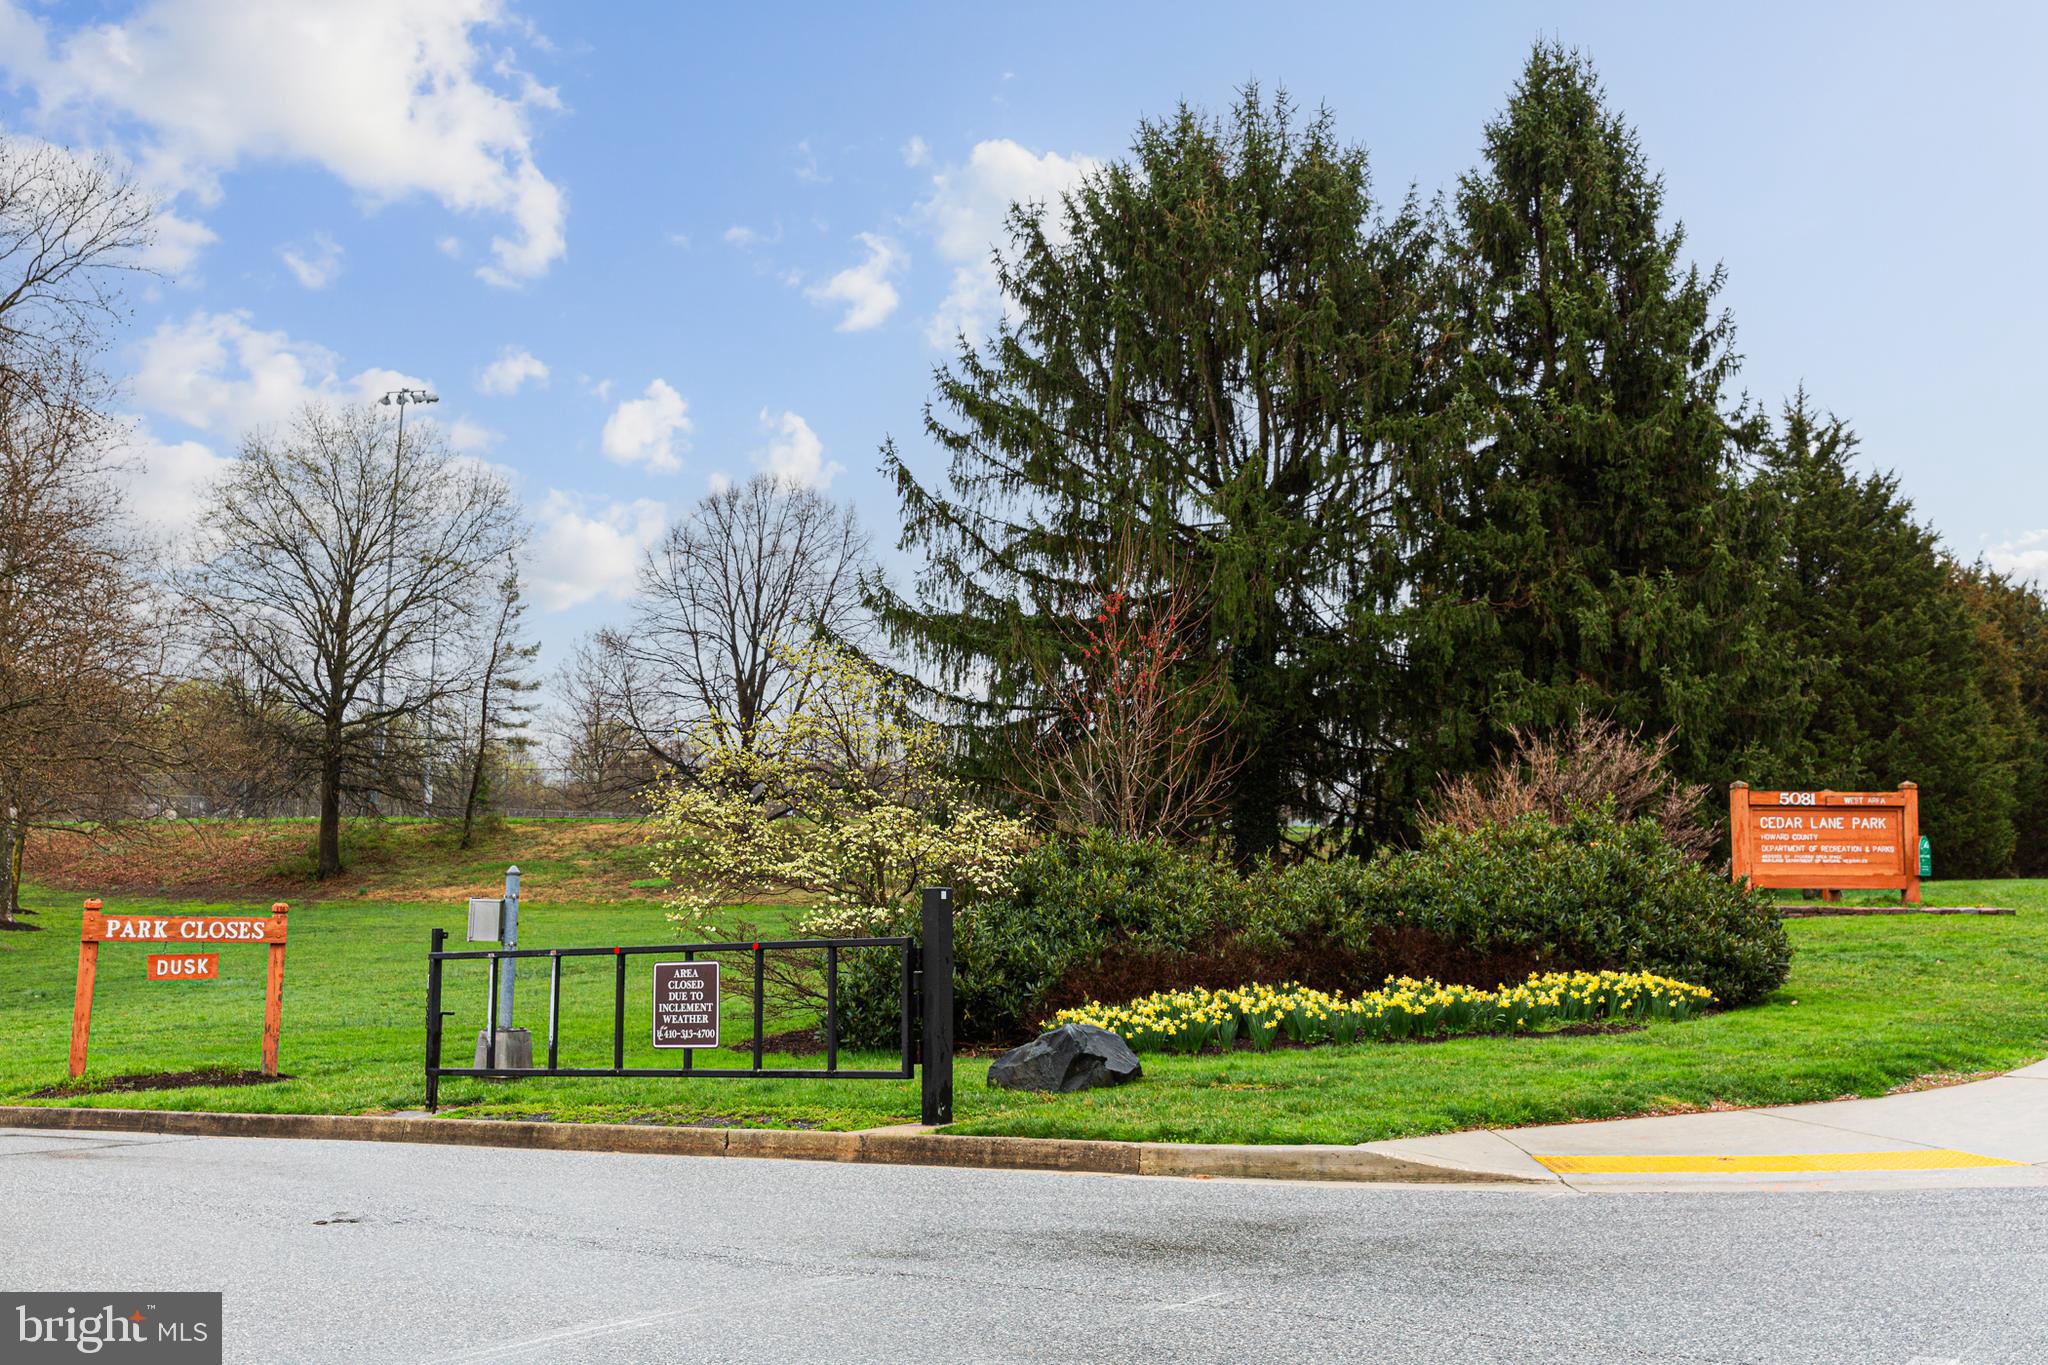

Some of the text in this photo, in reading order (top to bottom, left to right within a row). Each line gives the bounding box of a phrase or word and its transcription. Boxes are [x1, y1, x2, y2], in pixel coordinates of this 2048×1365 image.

[1779, 792, 1816, 805] 5081
[1843, 797, 1886, 805] WEST AREA
[1759, 816, 1887, 829] CEDAR LANE PARK
[1760, 833, 1818, 841] HOWARD COUNTY
[1760, 845, 1805, 853] DEPARTMENT
[1808, 845, 1818, 853] OF
[1820, 845, 1862, 853] RECREATION
[105, 919, 265, 939] PARK CLOSES
[156, 958, 209, 976] DUSK
[673, 968, 699, 978] AREA
[667, 980, 705, 990] CLOSED
[668, 991, 704, 1001] DUE TO
[658, 1002, 714, 1012] INCLEMENT
[662, 1014, 709, 1024] WEATHER
[663, 1029, 715, 1039] 410-313-4700
